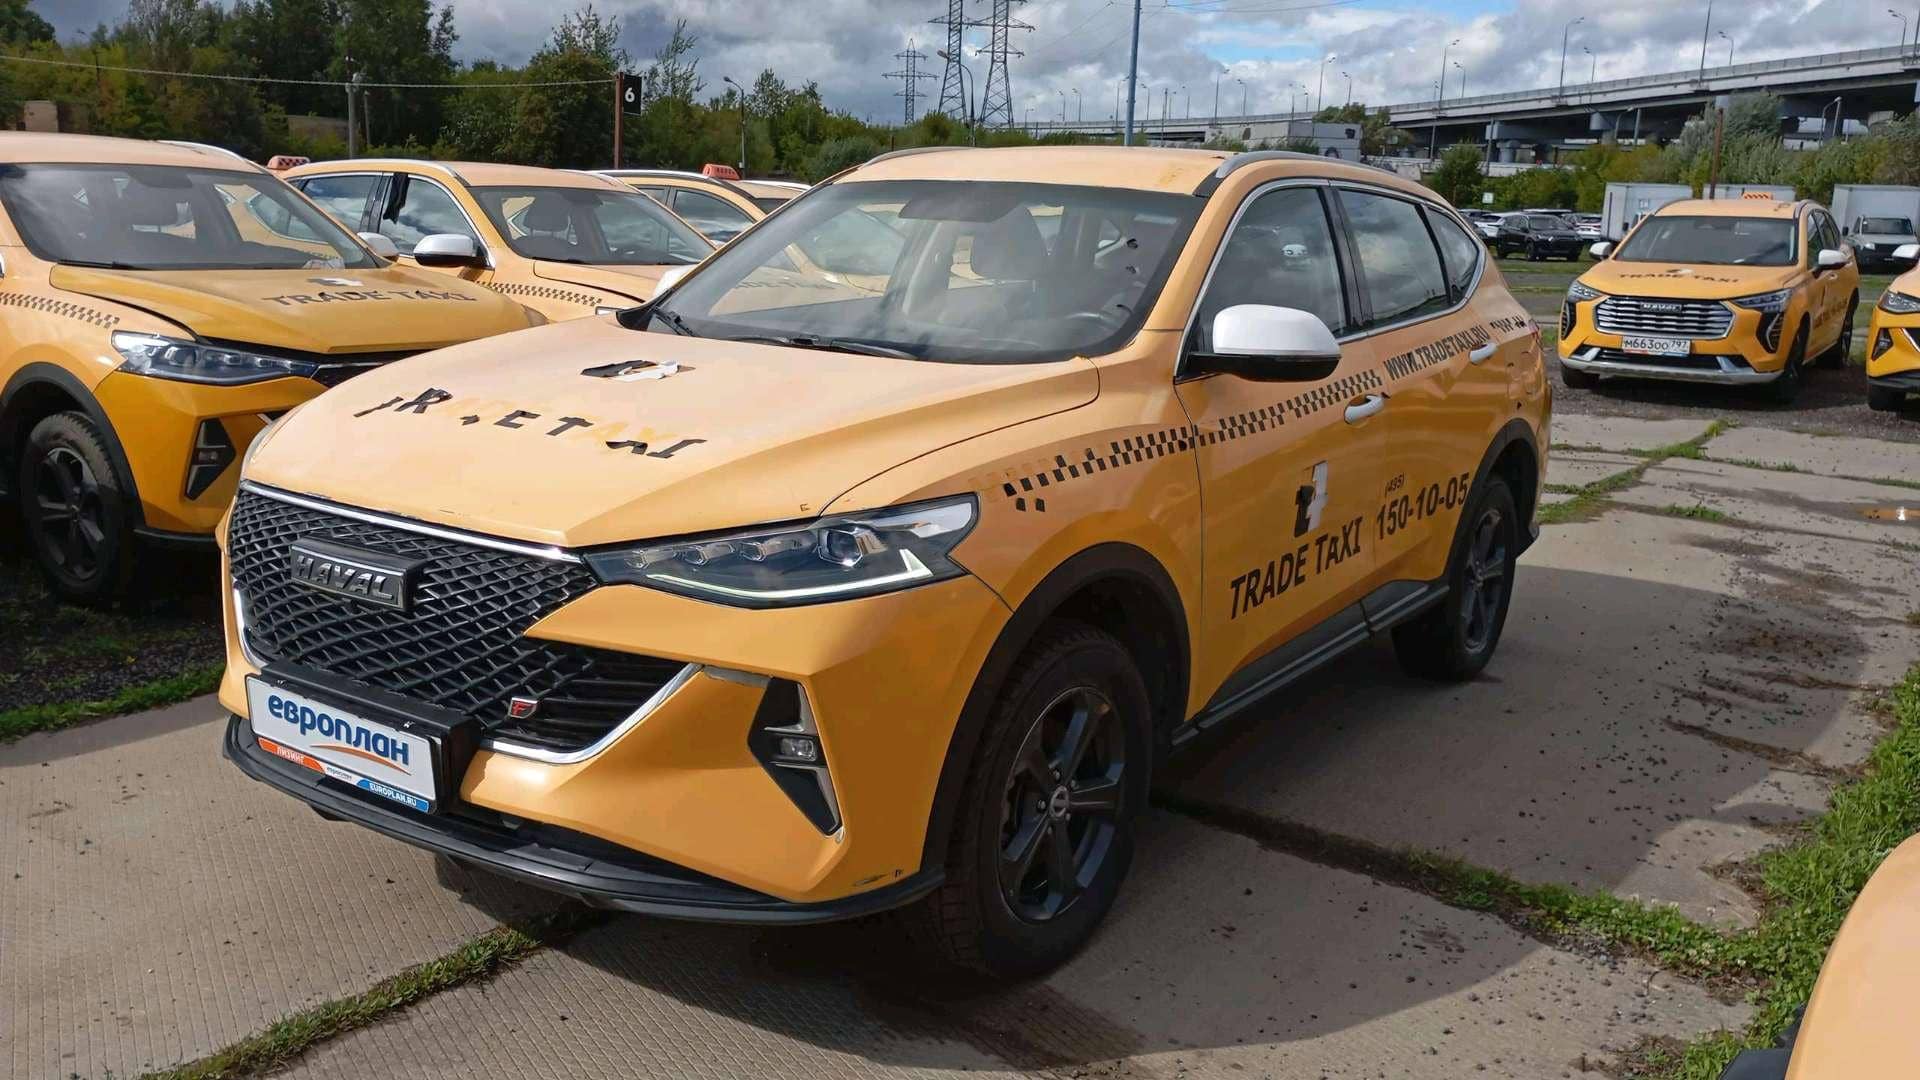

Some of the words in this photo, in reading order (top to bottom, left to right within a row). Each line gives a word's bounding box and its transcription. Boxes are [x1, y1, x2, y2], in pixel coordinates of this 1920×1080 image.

[625, 87, 635, 103] 6
[262, 290, 392, 307] TRADE
[1376, 472, 1470, 540] 150-10-05
[297, 555, 393, 600] HAVAL
[1230, 544, 1309, 620] TRADE
[268, 694, 409, 766] европлан
[368, 782, 417, 807] EUROPLAN.RU
